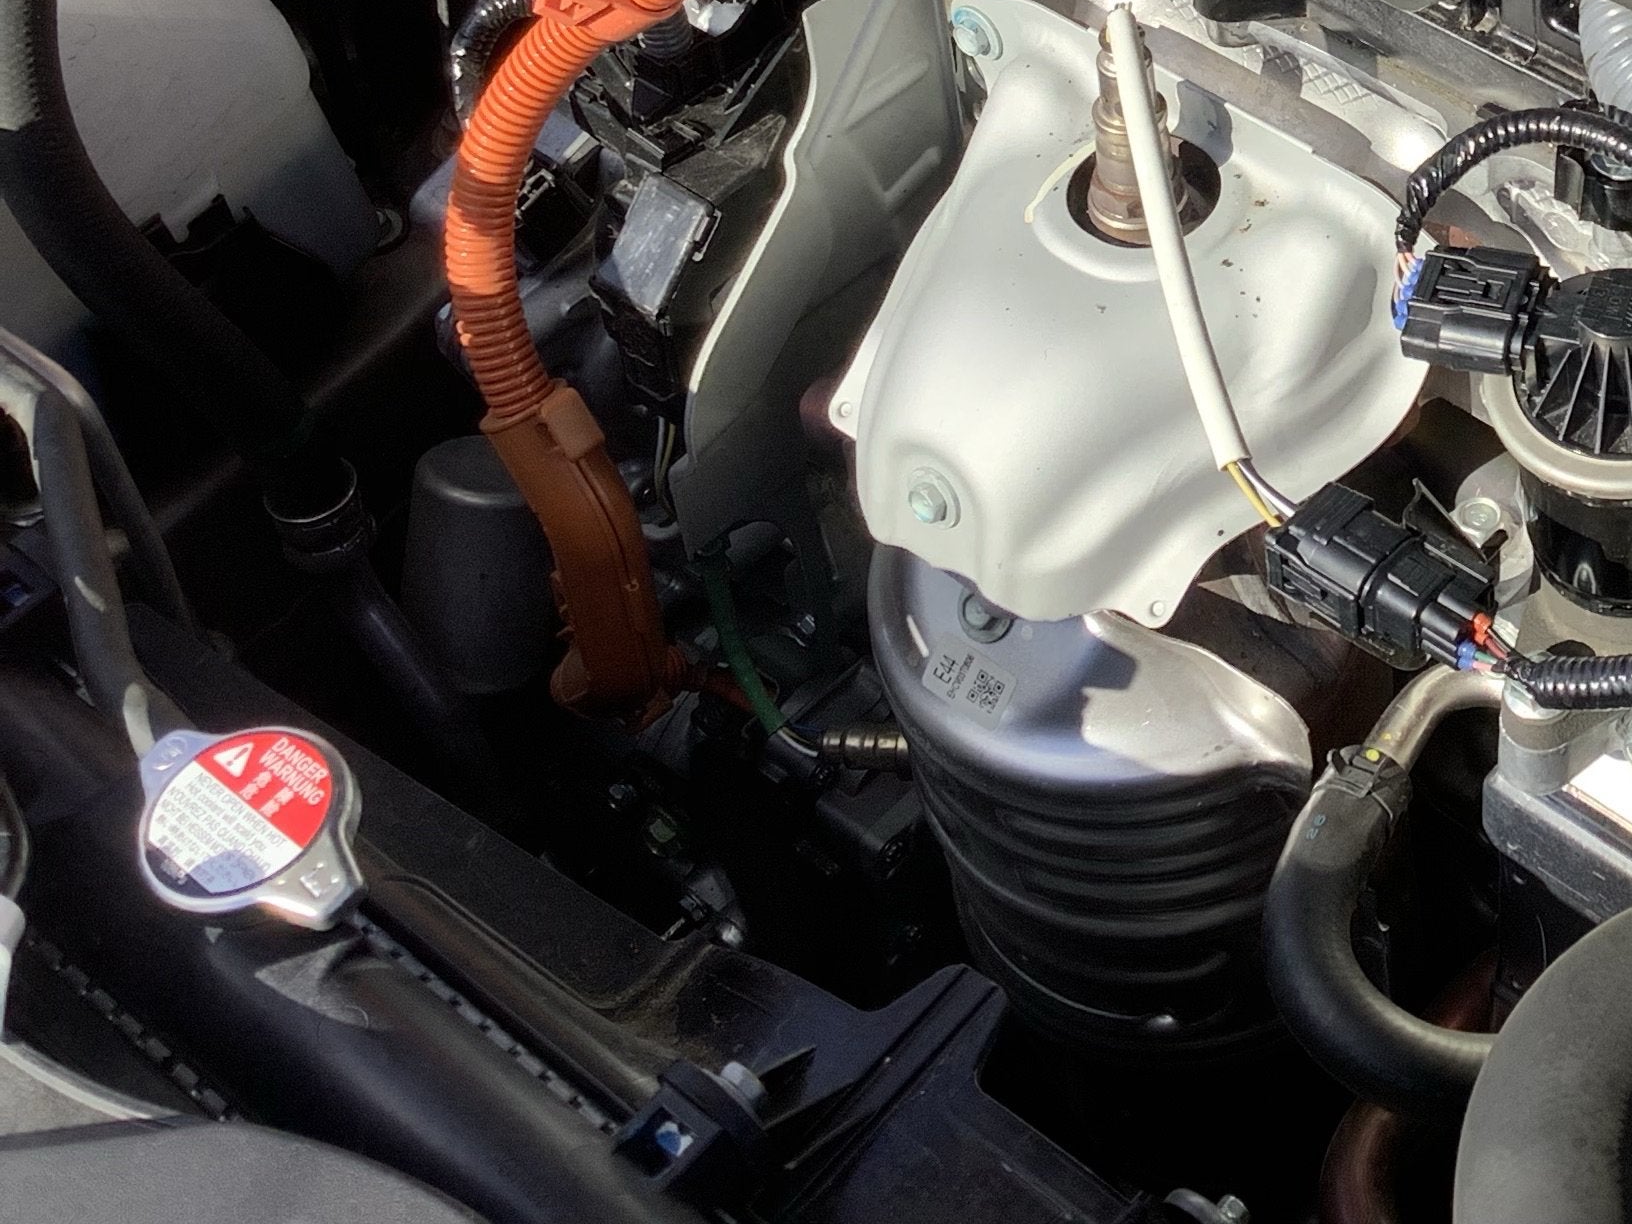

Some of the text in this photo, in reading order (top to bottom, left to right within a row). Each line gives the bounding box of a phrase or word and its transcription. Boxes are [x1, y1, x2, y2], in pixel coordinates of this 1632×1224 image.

[932, 653, 959, 684] E44
[259, 749, 326, 806] WARNUNG
[271, 737, 329, 785] DANGER
